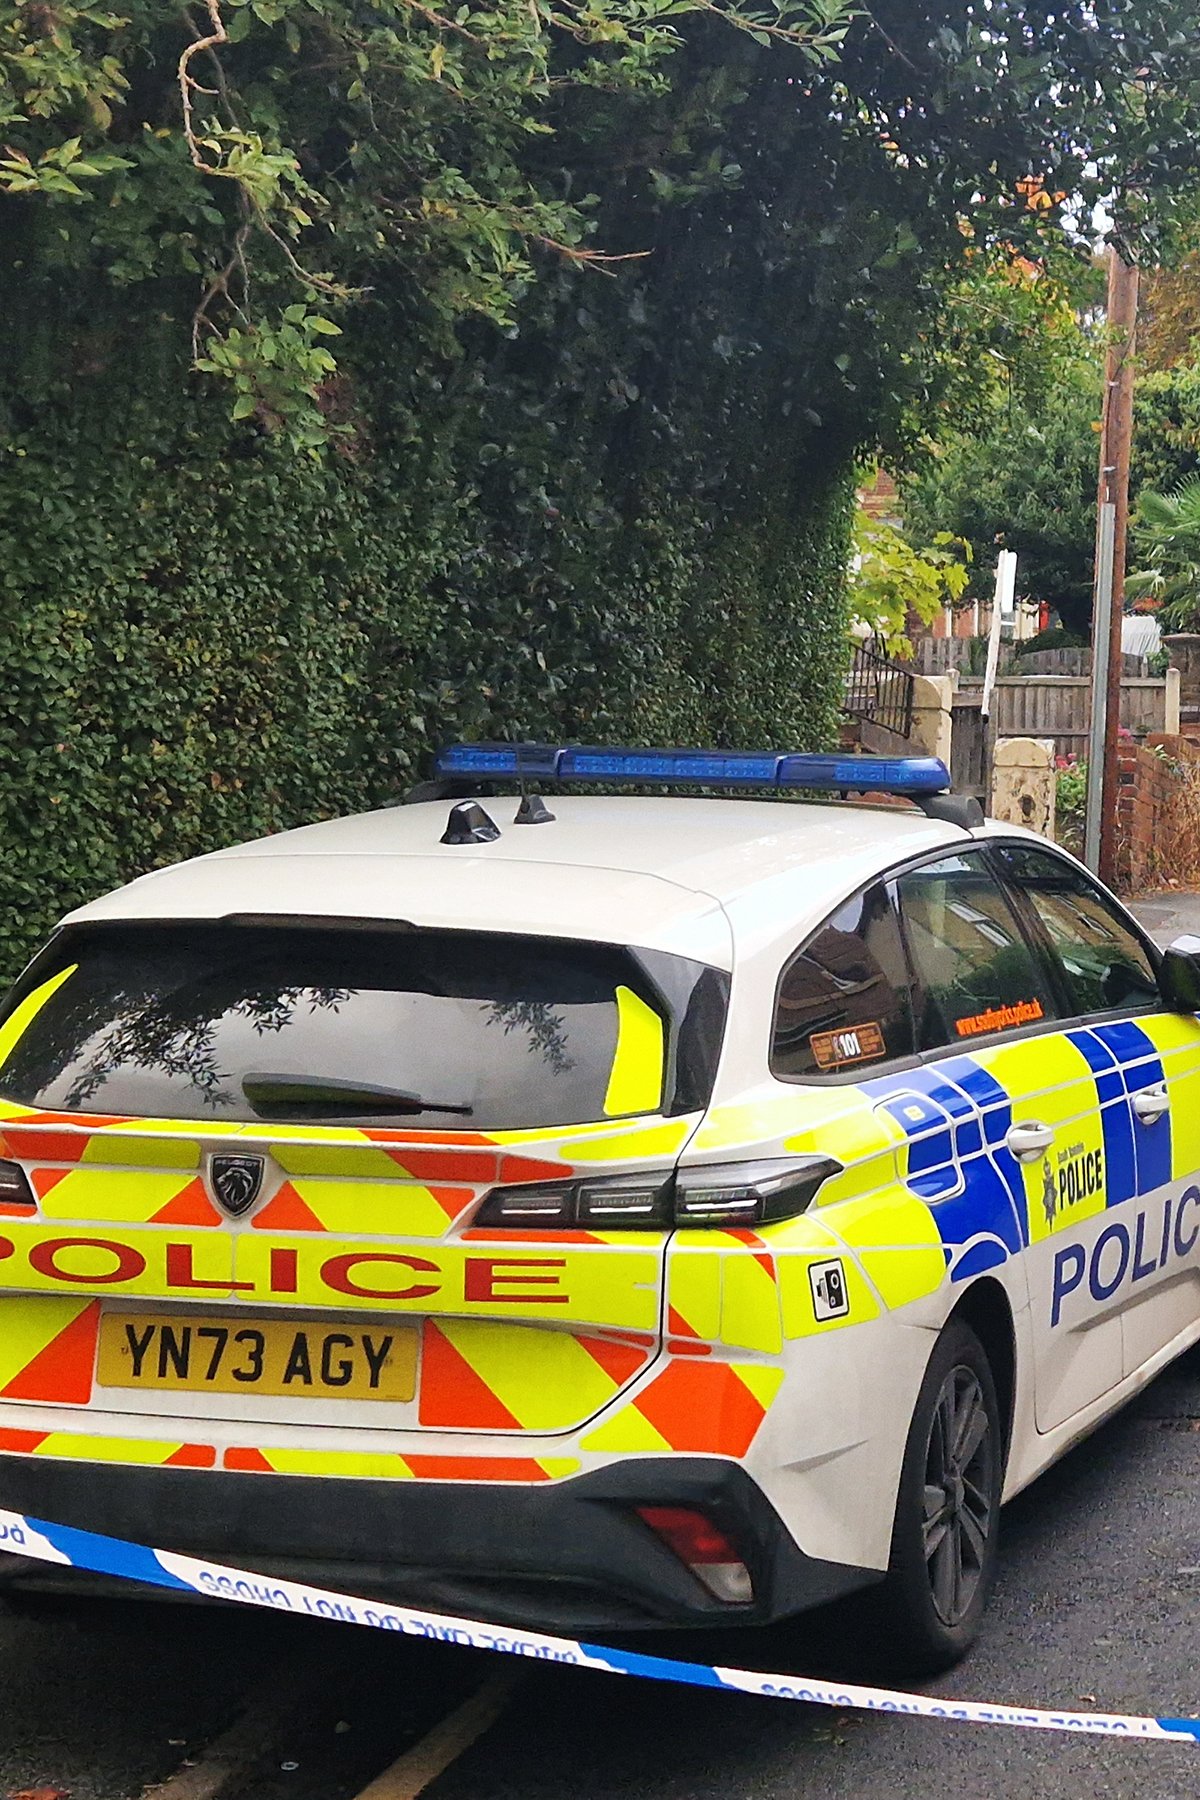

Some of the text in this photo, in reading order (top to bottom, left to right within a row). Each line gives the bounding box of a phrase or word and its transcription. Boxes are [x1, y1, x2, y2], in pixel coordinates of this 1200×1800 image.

[842, 1032, 861, 1057] 101
[214, 1159, 259, 1167] PEUGEOT
[1058, 1149, 1103, 1211] POLICE
[0, 1235, 570, 1304] OLICE
[124, 1324, 394, 1389] YN73 AGY
